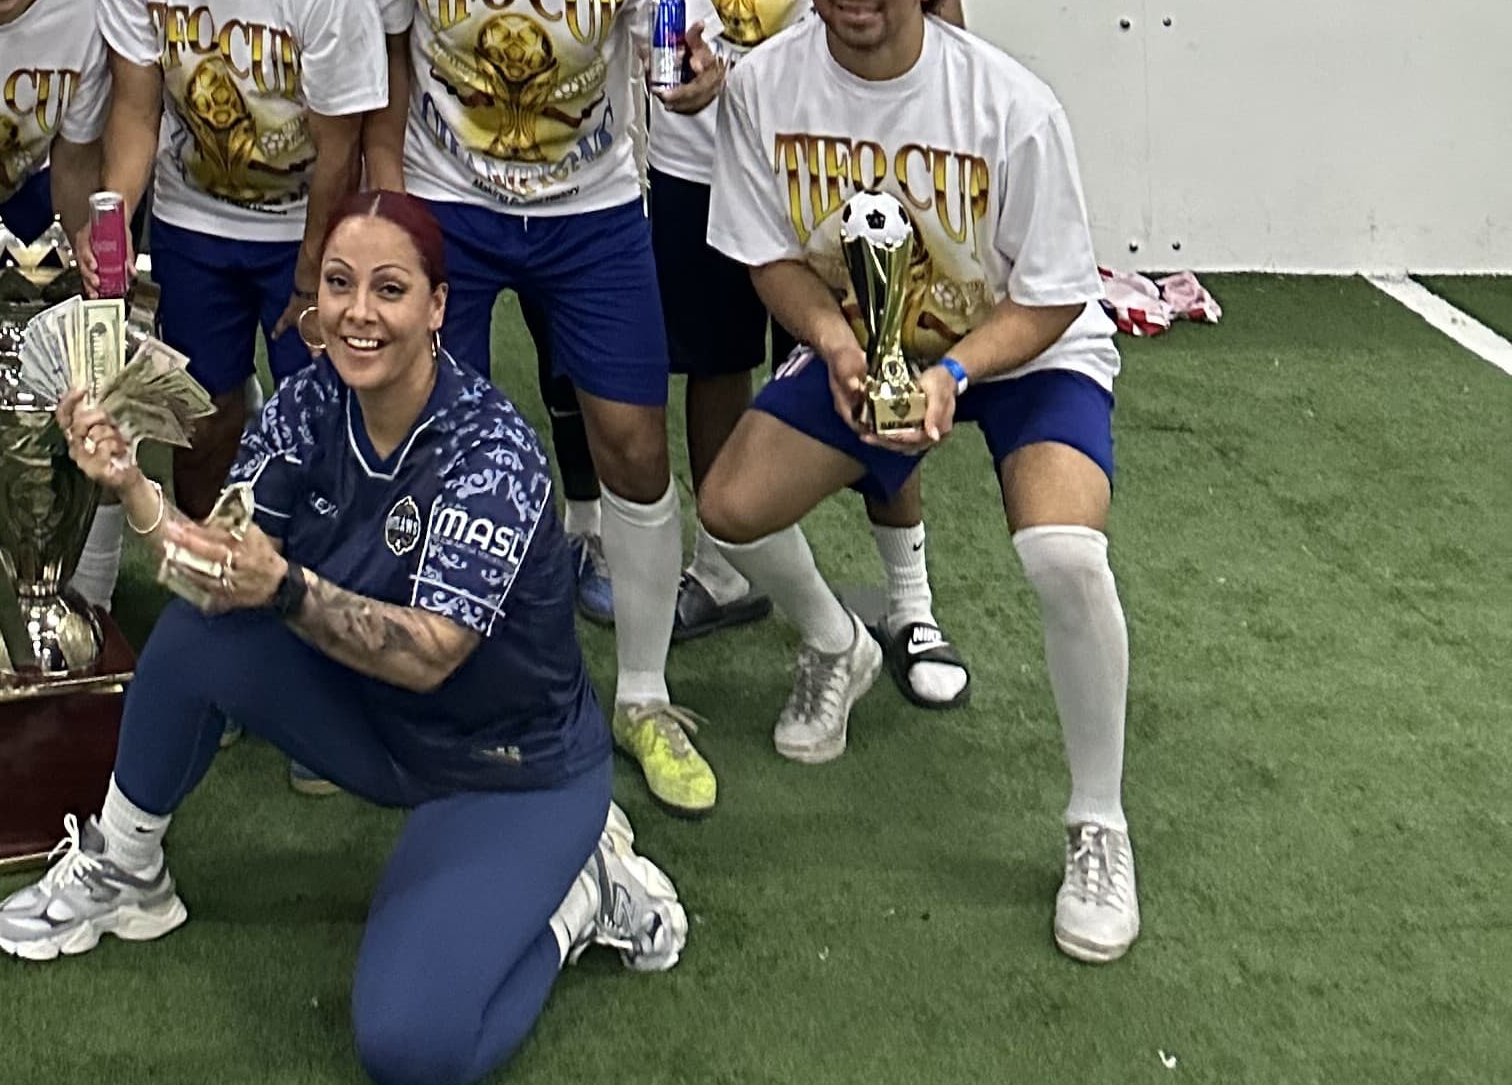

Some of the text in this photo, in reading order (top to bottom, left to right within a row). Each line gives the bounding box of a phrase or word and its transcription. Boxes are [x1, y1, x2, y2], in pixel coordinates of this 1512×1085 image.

[775, 132, 989, 263] TIFO CUP
[433, 507, 520, 565] MASL
